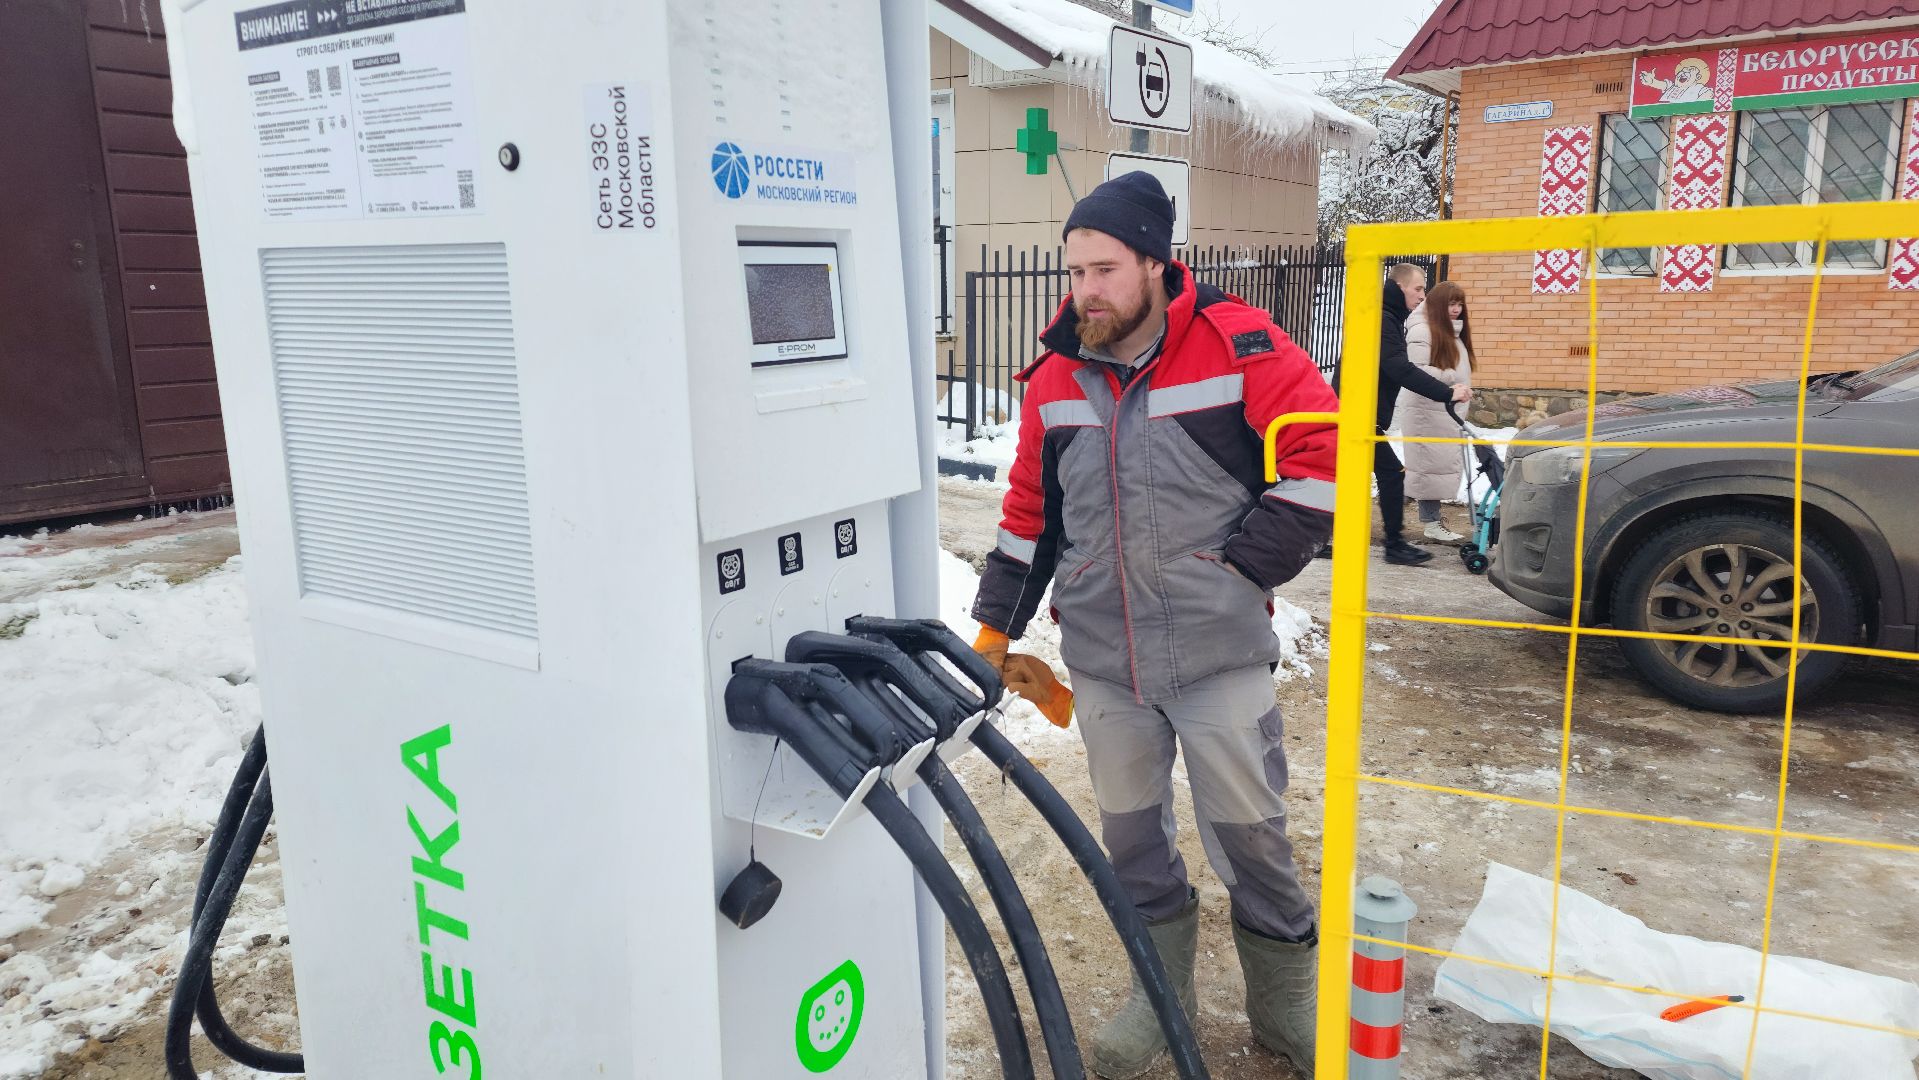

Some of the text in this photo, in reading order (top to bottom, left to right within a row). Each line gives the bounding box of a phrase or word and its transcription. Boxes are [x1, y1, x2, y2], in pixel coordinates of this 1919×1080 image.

[240, 10, 309, 41] ВНИМАНИЕ!
[296, 32, 395, 58] СТРОГО СЛЕДУЙТЕ ИНСТРУКЦИИ!
[1780, 64, 1918, 90] ПРОДУКТЫ
[1487, 109, 1532, 119] ГАГАРИНА
[608, 86, 634, 228] Московской
[754, 154, 824, 181] РОССЕТИ
[590, 123, 613, 229] Сеть ЭЗС
[637, 136, 656, 229] области
[757, 184, 857, 205] МОСКОВСКИЙ РЕГИОН
[840, 545, 853, 555] GB/T
[724, 577, 741, 589] GB/T
